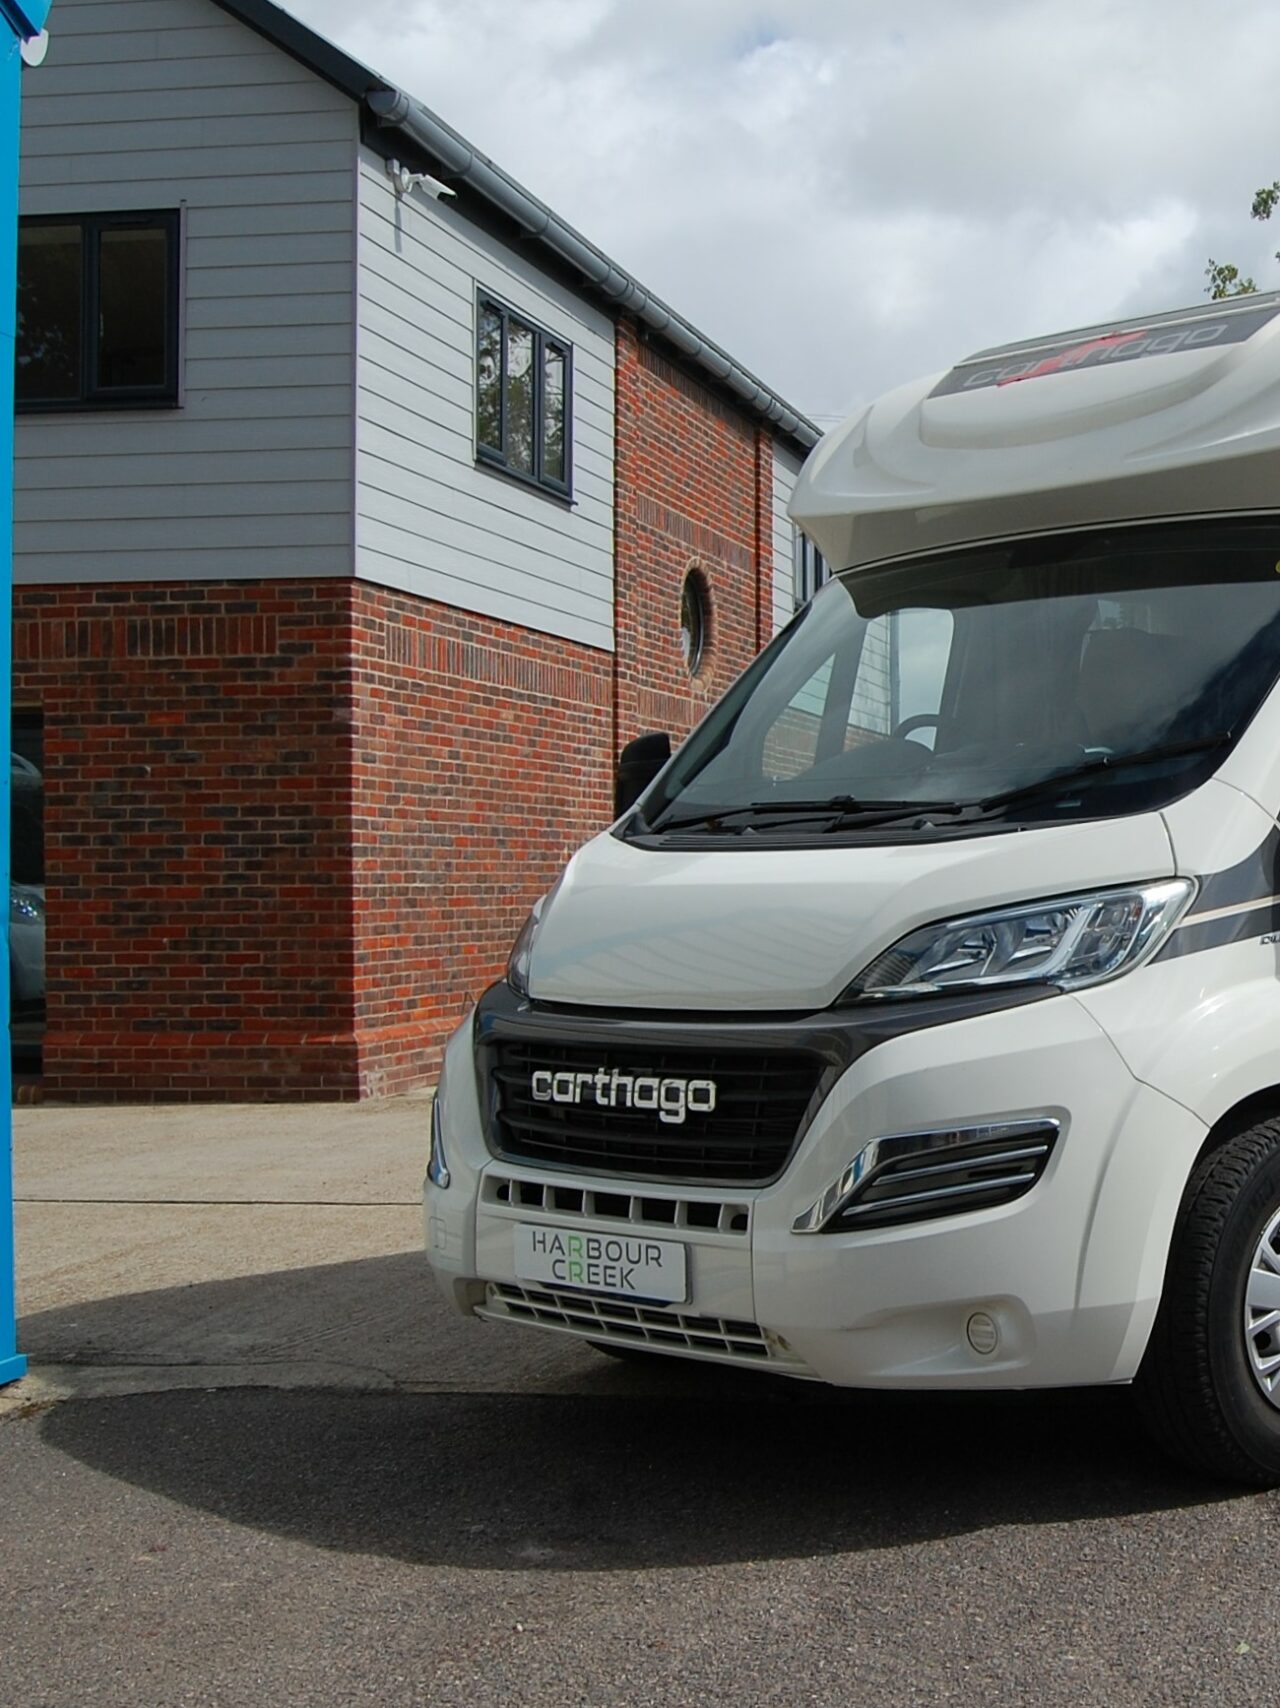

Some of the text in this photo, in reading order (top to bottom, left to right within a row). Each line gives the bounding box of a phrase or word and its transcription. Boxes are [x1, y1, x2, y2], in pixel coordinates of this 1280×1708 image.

[532, 1067, 716, 1124] carthago
[532, 1230, 663, 1268] HARBOUR
[552, 1258, 636, 1291] CREEK
